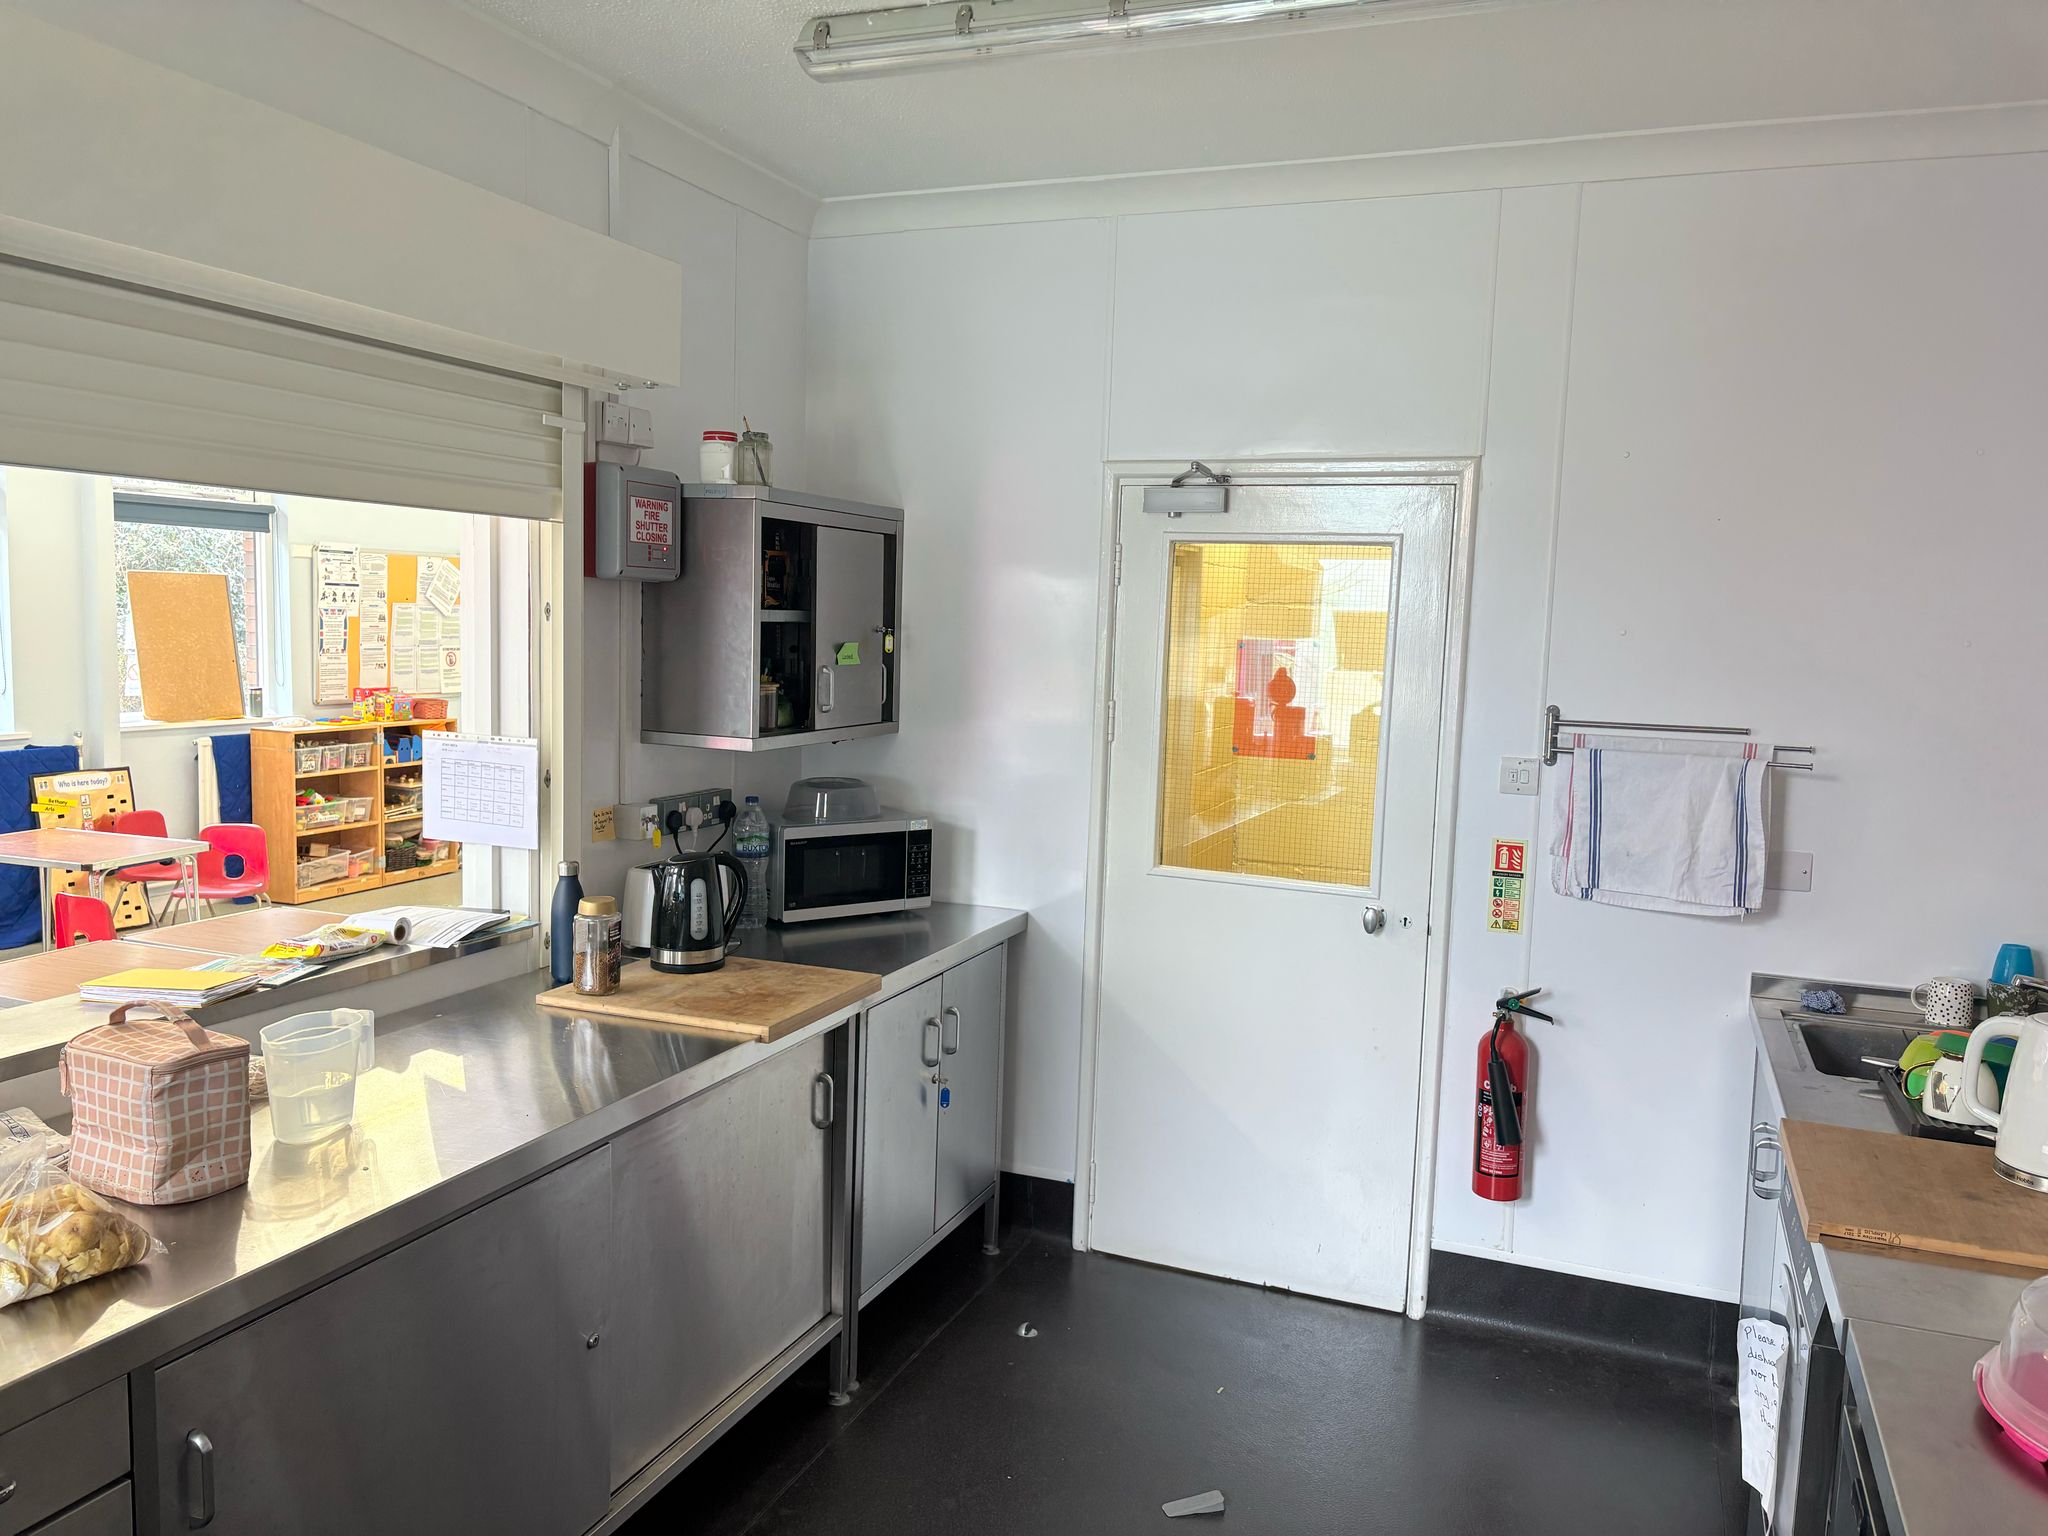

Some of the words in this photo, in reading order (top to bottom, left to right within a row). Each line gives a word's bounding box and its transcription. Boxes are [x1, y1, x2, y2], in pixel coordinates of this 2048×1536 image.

[635, 499, 668, 512] WARNING
[644, 511, 660, 521] FIRE
[635, 521, 668, 533] SHUTTER
[636, 532, 667, 543] CLOSING
[77, 778, 90, 787] here
[90, 777, 108, 786] today?
[48, 798, 68, 806] Bethany
[1744, 1324, 1776, 1347] Please
[1747, 1345, 1777, 1367] dishwa
[1750, 1368, 1767, 1382] NOT
[1759, 1407, 1776, 1431] than
